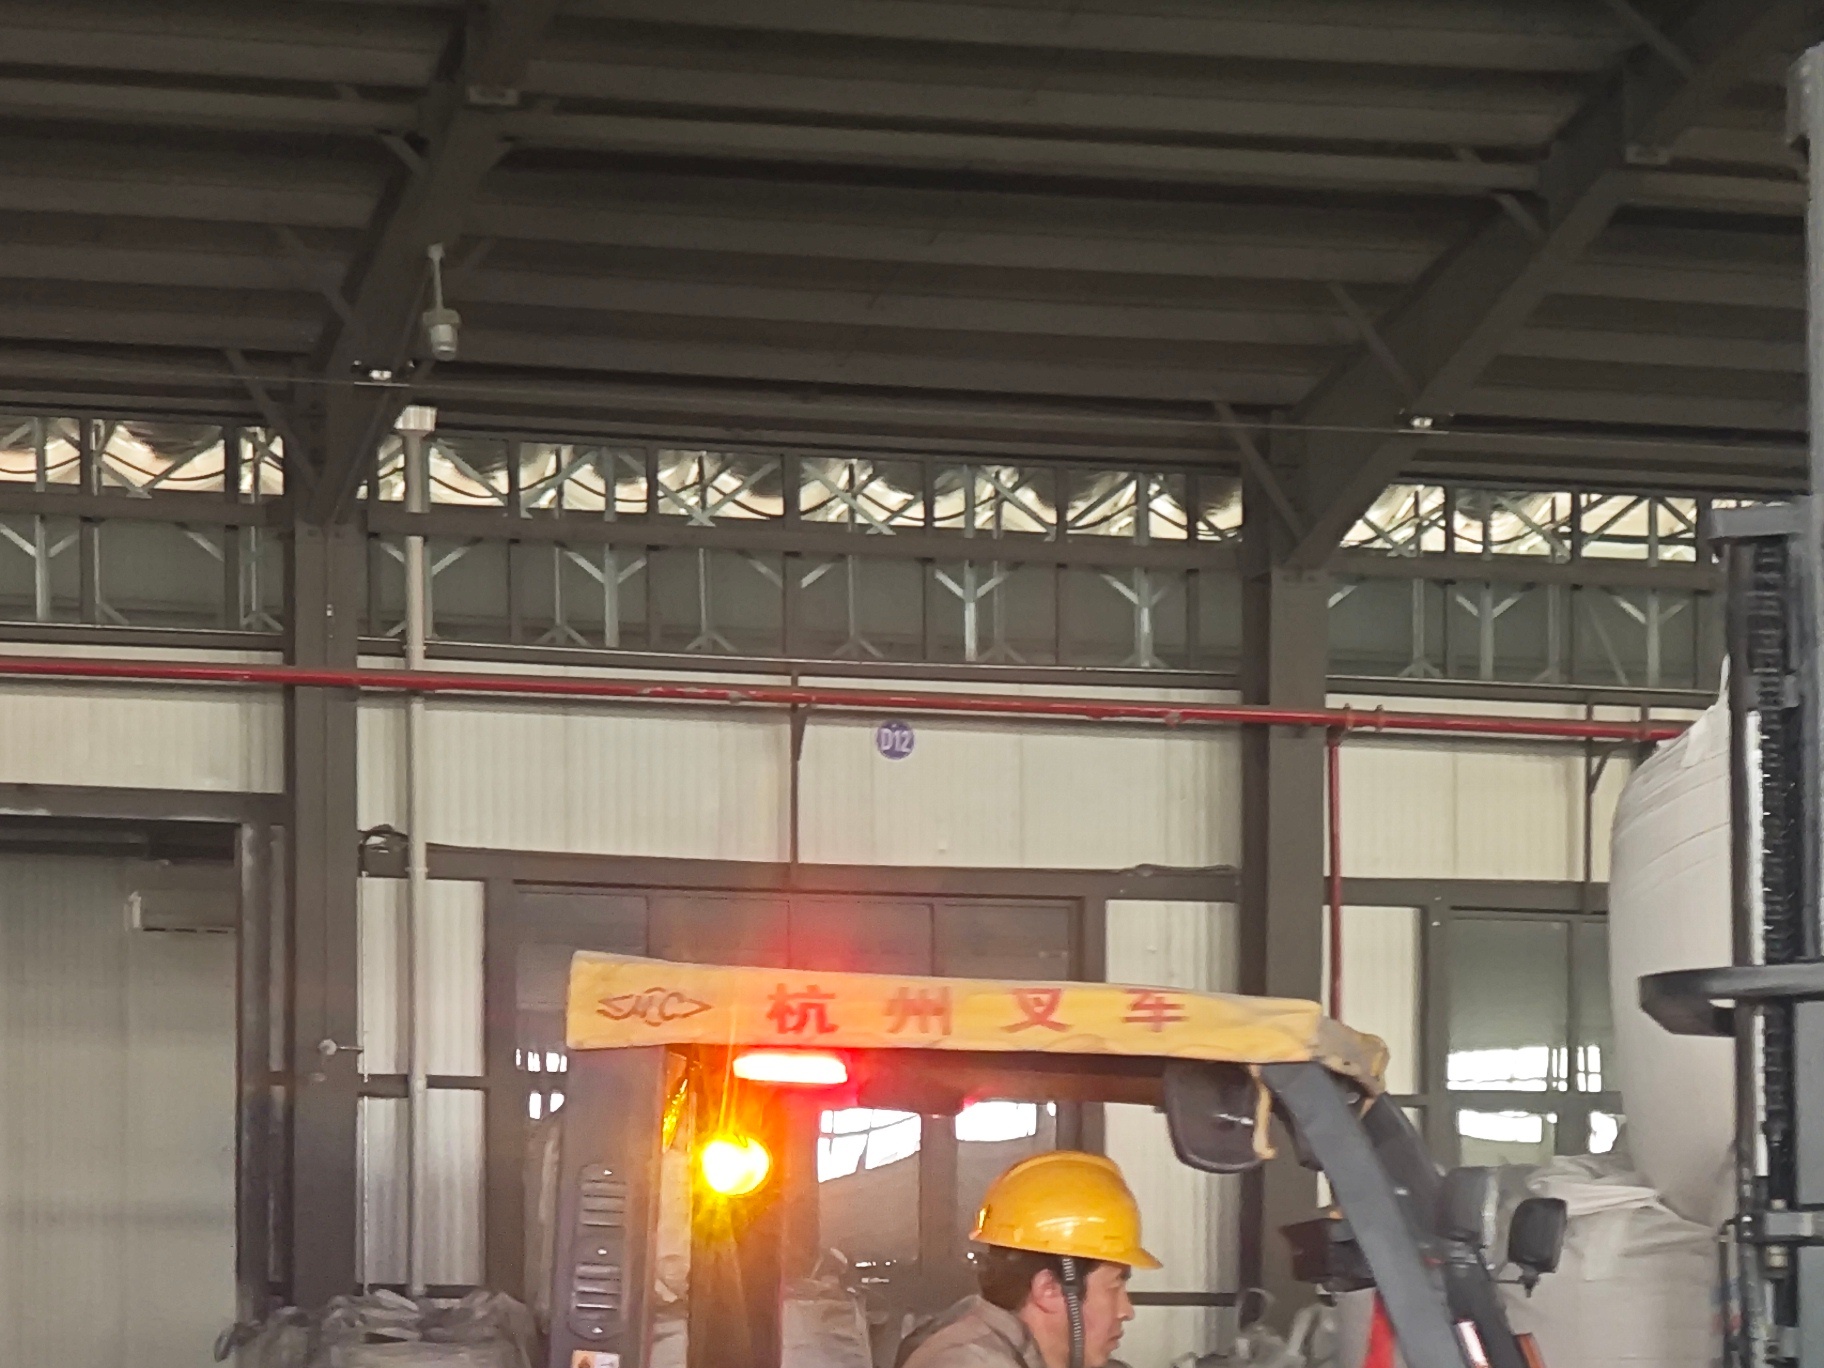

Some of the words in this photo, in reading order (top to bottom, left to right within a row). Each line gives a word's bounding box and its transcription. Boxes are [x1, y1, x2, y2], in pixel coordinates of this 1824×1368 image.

[880, 728, 912, 753] D12
[765, 982, 1192, 1036] 杭州叉车
